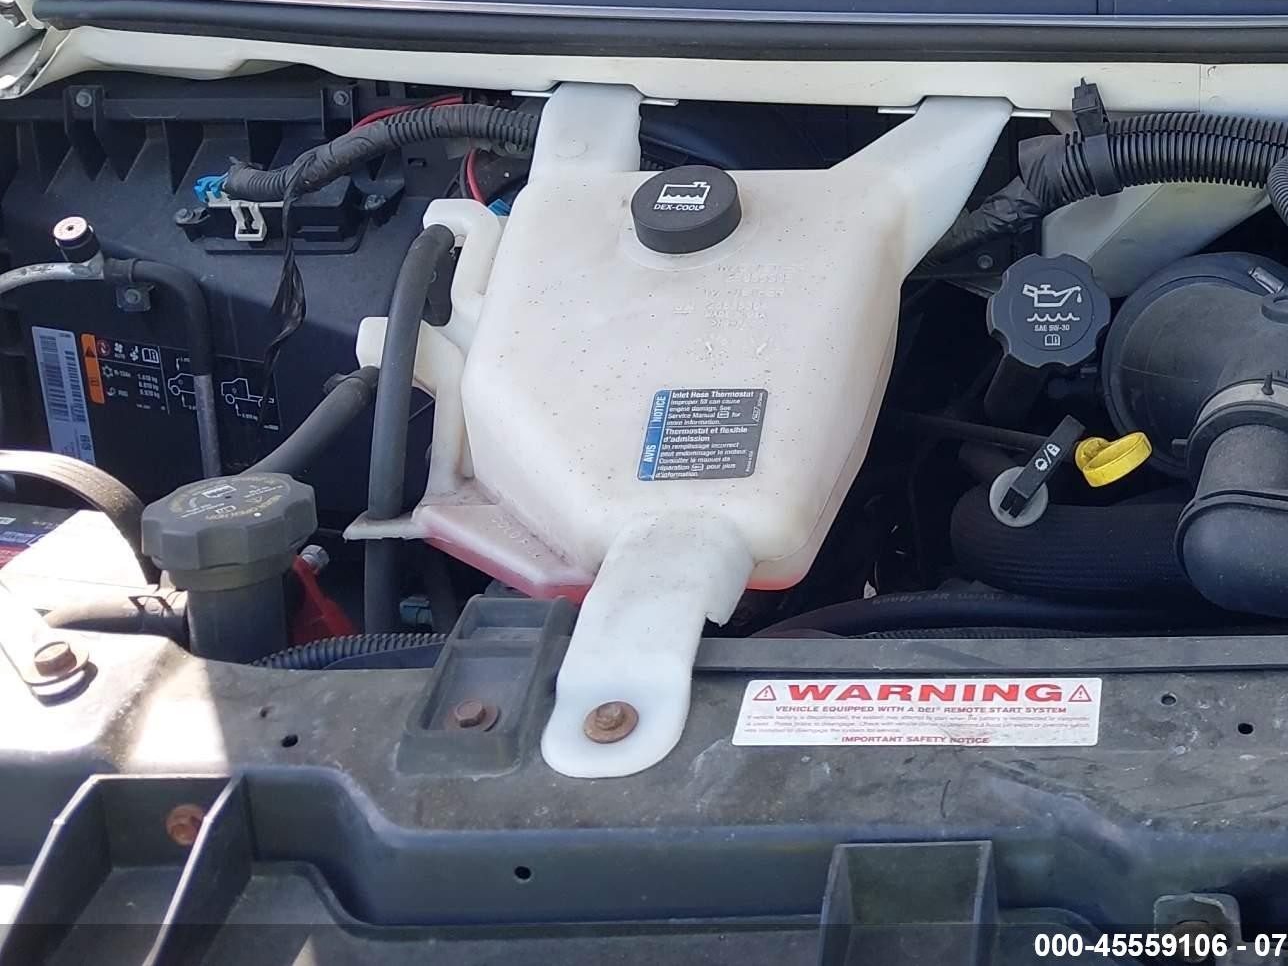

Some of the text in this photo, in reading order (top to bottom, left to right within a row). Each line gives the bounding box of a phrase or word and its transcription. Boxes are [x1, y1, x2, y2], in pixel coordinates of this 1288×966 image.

[1034, 324, 1070, 332] SAE 5W-30
[672, 391, 689, 399] Inlet
[711, 390, 754, 398] Thermostat
[650, 395, 666, 423] NOTICE
[665, 427, 709, 435] Thermostat
[719, 426, 748, 434] flexible
[663, 435, 711, 443] d'admission
[643, 444, 657, 464] AVIS
[787, 684, 1063, 702] WARNING
